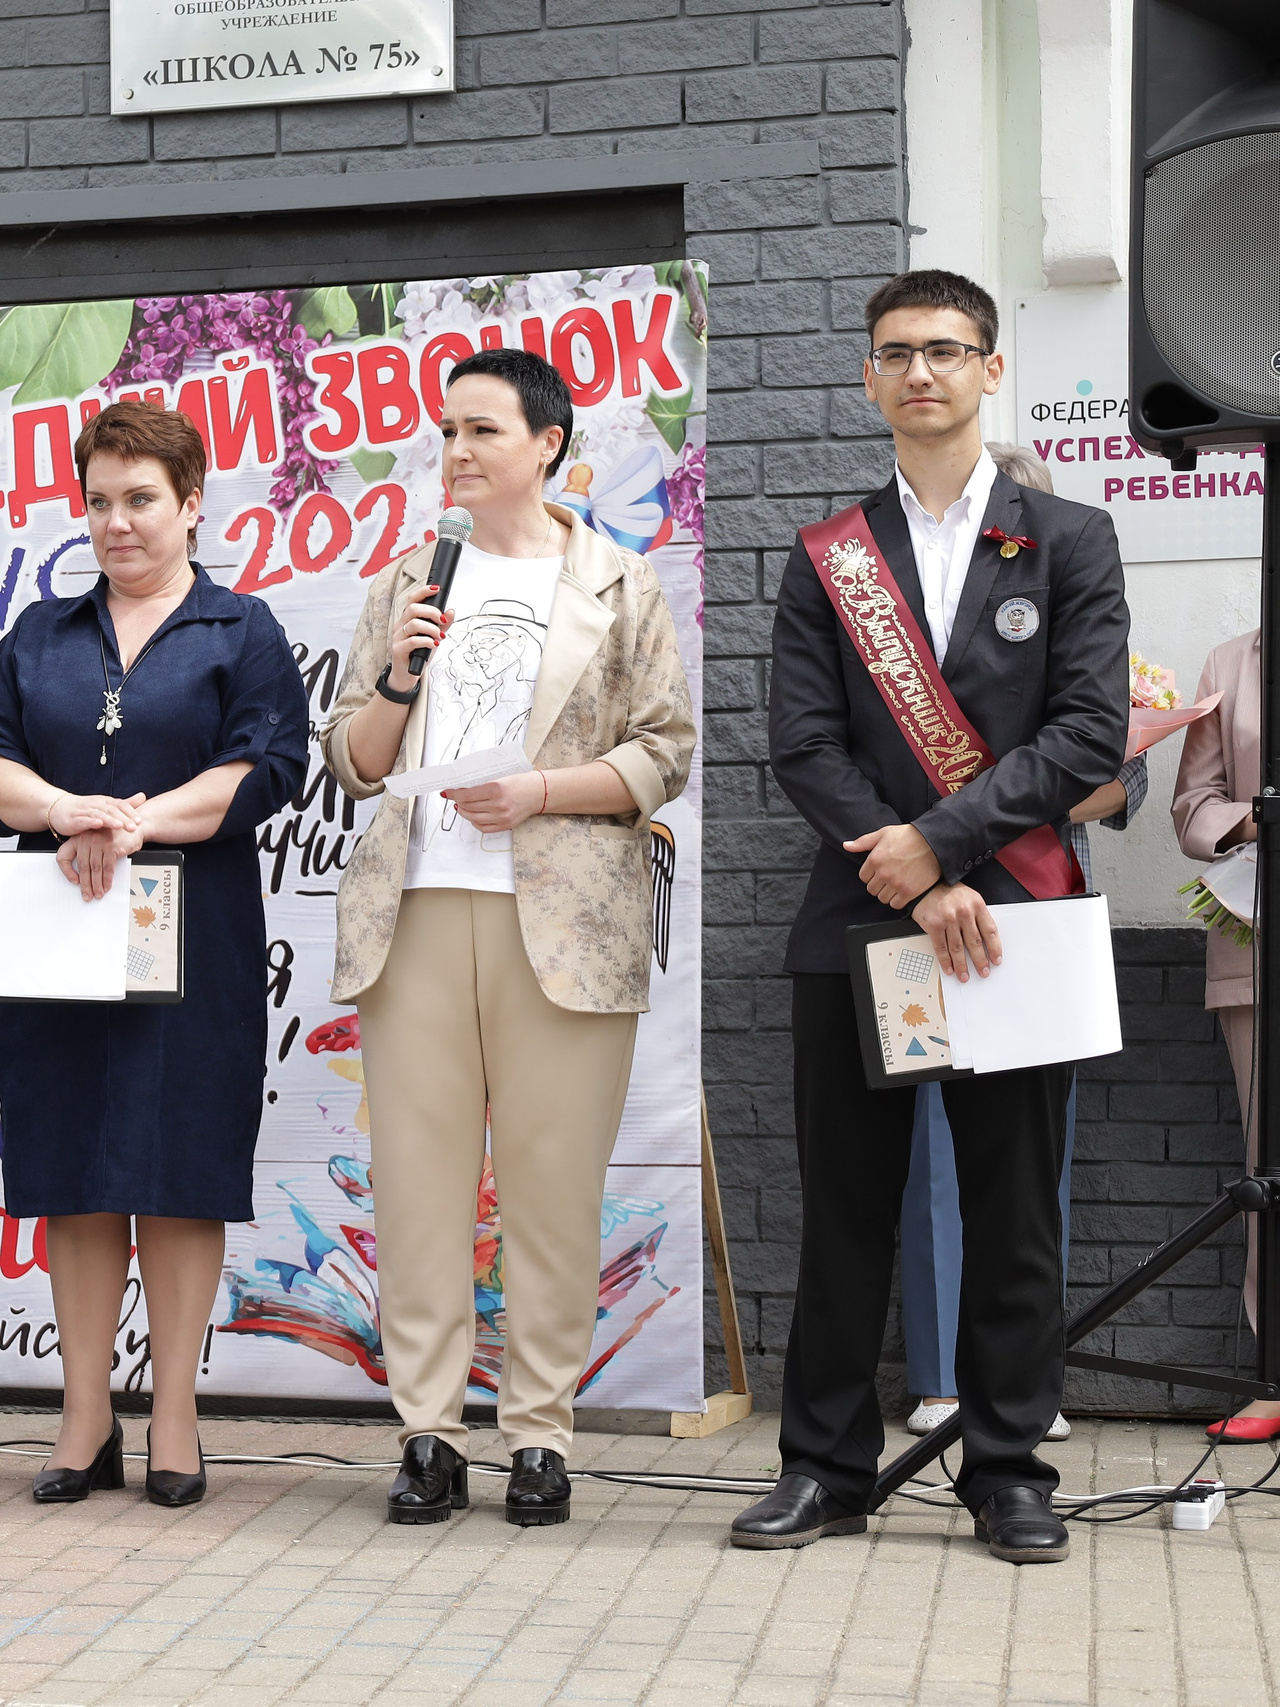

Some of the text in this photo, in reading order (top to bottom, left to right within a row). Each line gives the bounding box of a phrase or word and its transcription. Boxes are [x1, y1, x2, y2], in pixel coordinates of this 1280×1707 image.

[221, 10, 337, 30] УЧРЕЖДЕНИЕ
[143, 42, 421, 86] «ШКОЛА № 75»
[307, 293, 683, 452] ЗВООК
[1032, 435, 1146, 463] УСПЕХ
[1104, 471, 1265, 502] РЕБЕНКА
[224, 476, 455, 594] 202
[844, 581, 950, 746] Выпускник
[159, 869, 172, 931] 9 классы
[879, 1015, 894, 1065] классы
